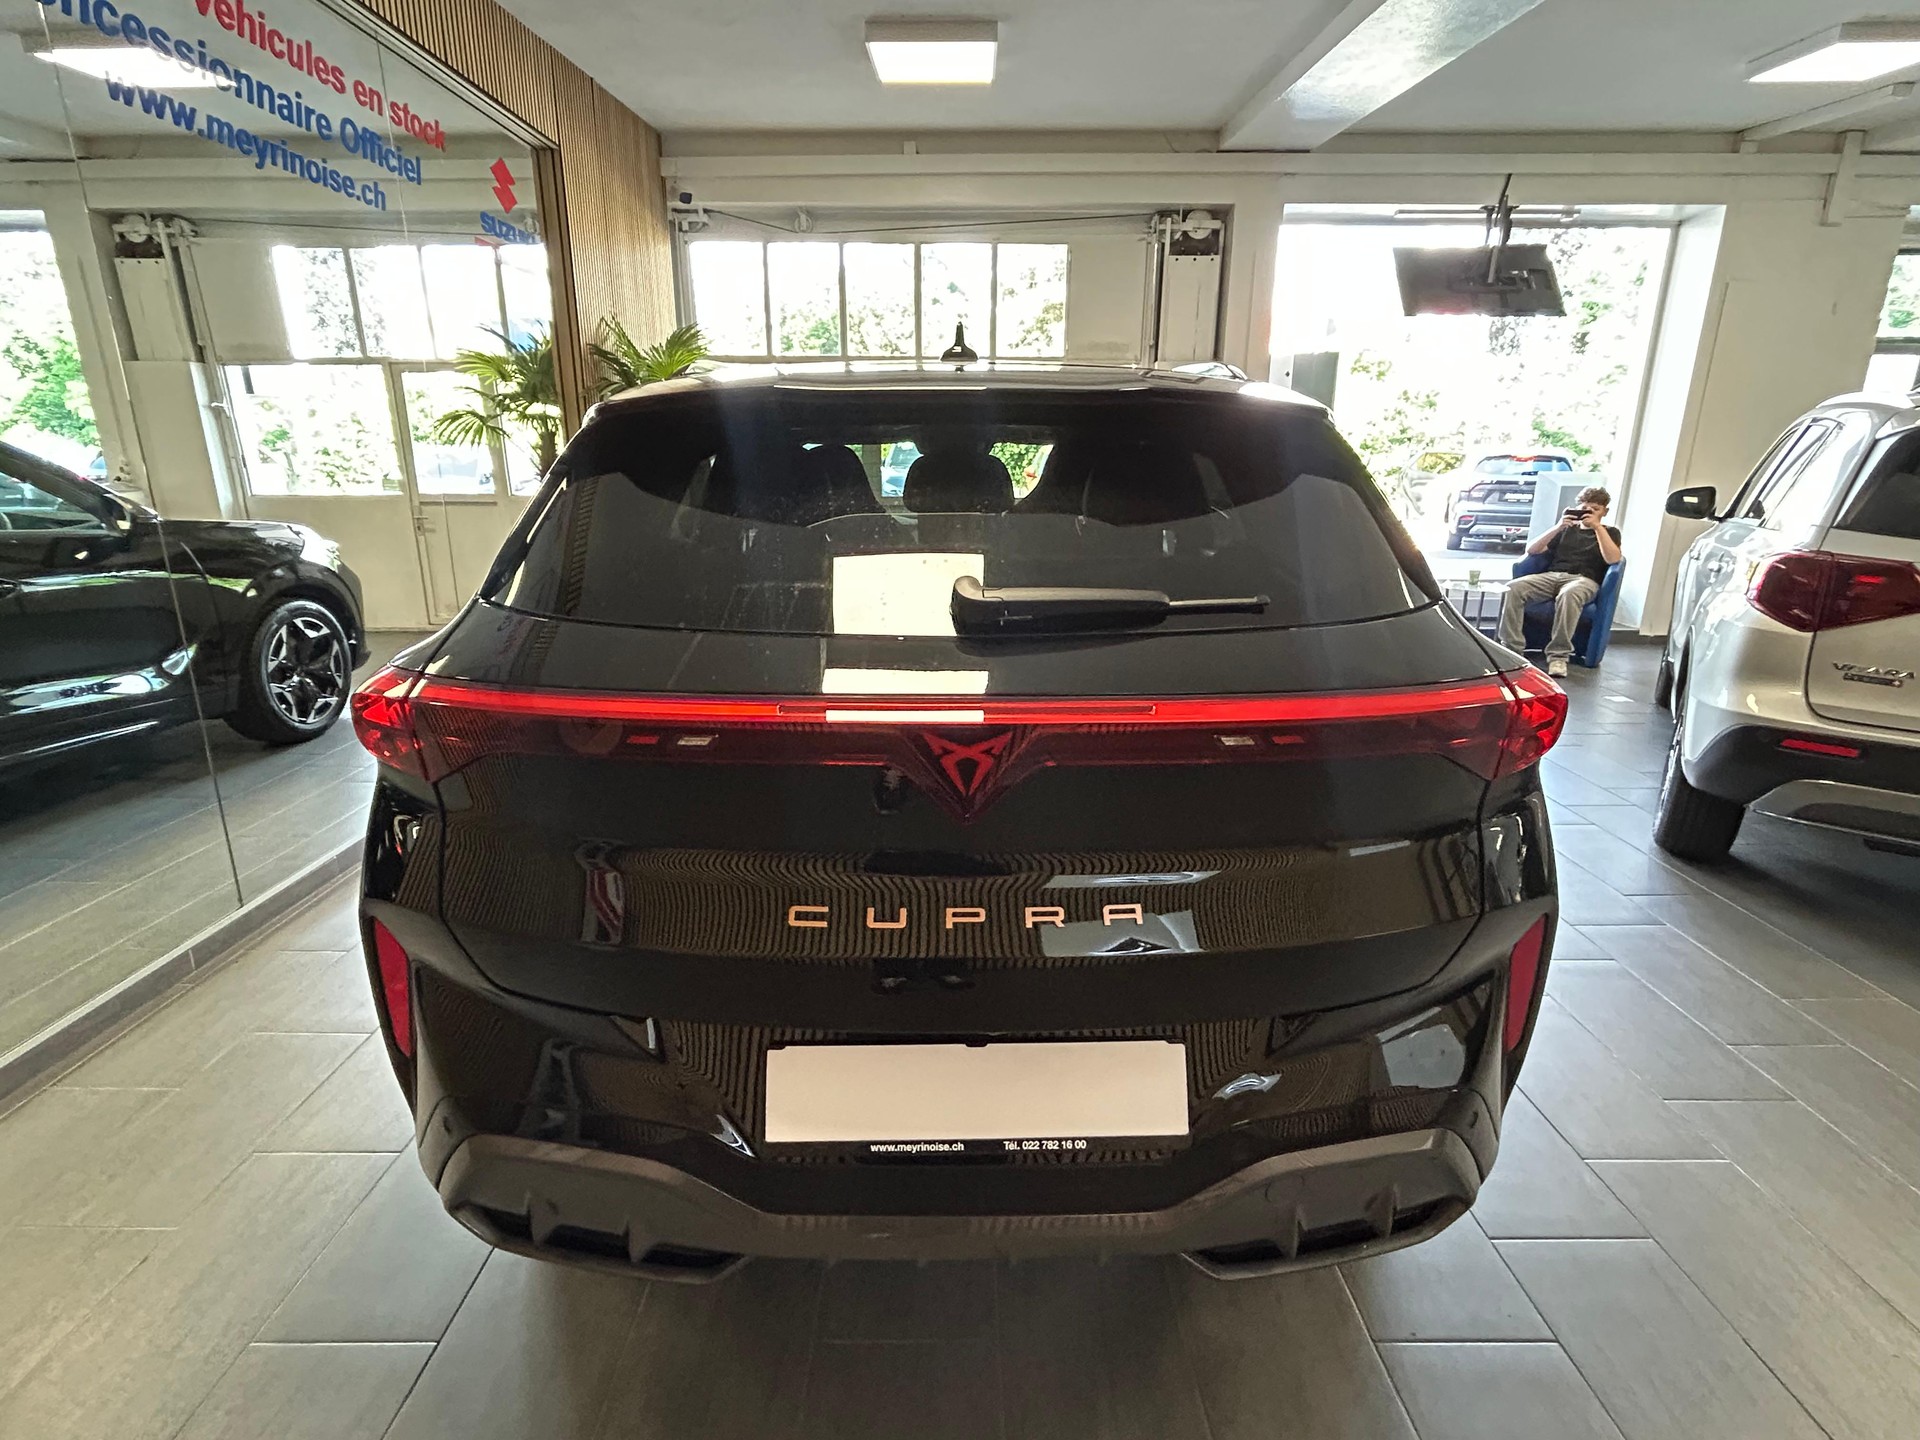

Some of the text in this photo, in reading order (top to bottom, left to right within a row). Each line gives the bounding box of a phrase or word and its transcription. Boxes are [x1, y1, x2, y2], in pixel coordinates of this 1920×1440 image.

[35, 0, 422, 186] ncessionnaire Officiel
[353, 79, 384, 117] en
[389, 100, 446, 153] stock
[105, 70, 387, 212] www.meyrinoise.ch
[1832, 661, 1915, 680] VIARA
[787, 903, 1144, 929] CUPRA
[870, 1142, 965, 1154] www.meyrinoise.ch
[1003, 1140, 1087, 1150] Tél. 022 782 16 00
